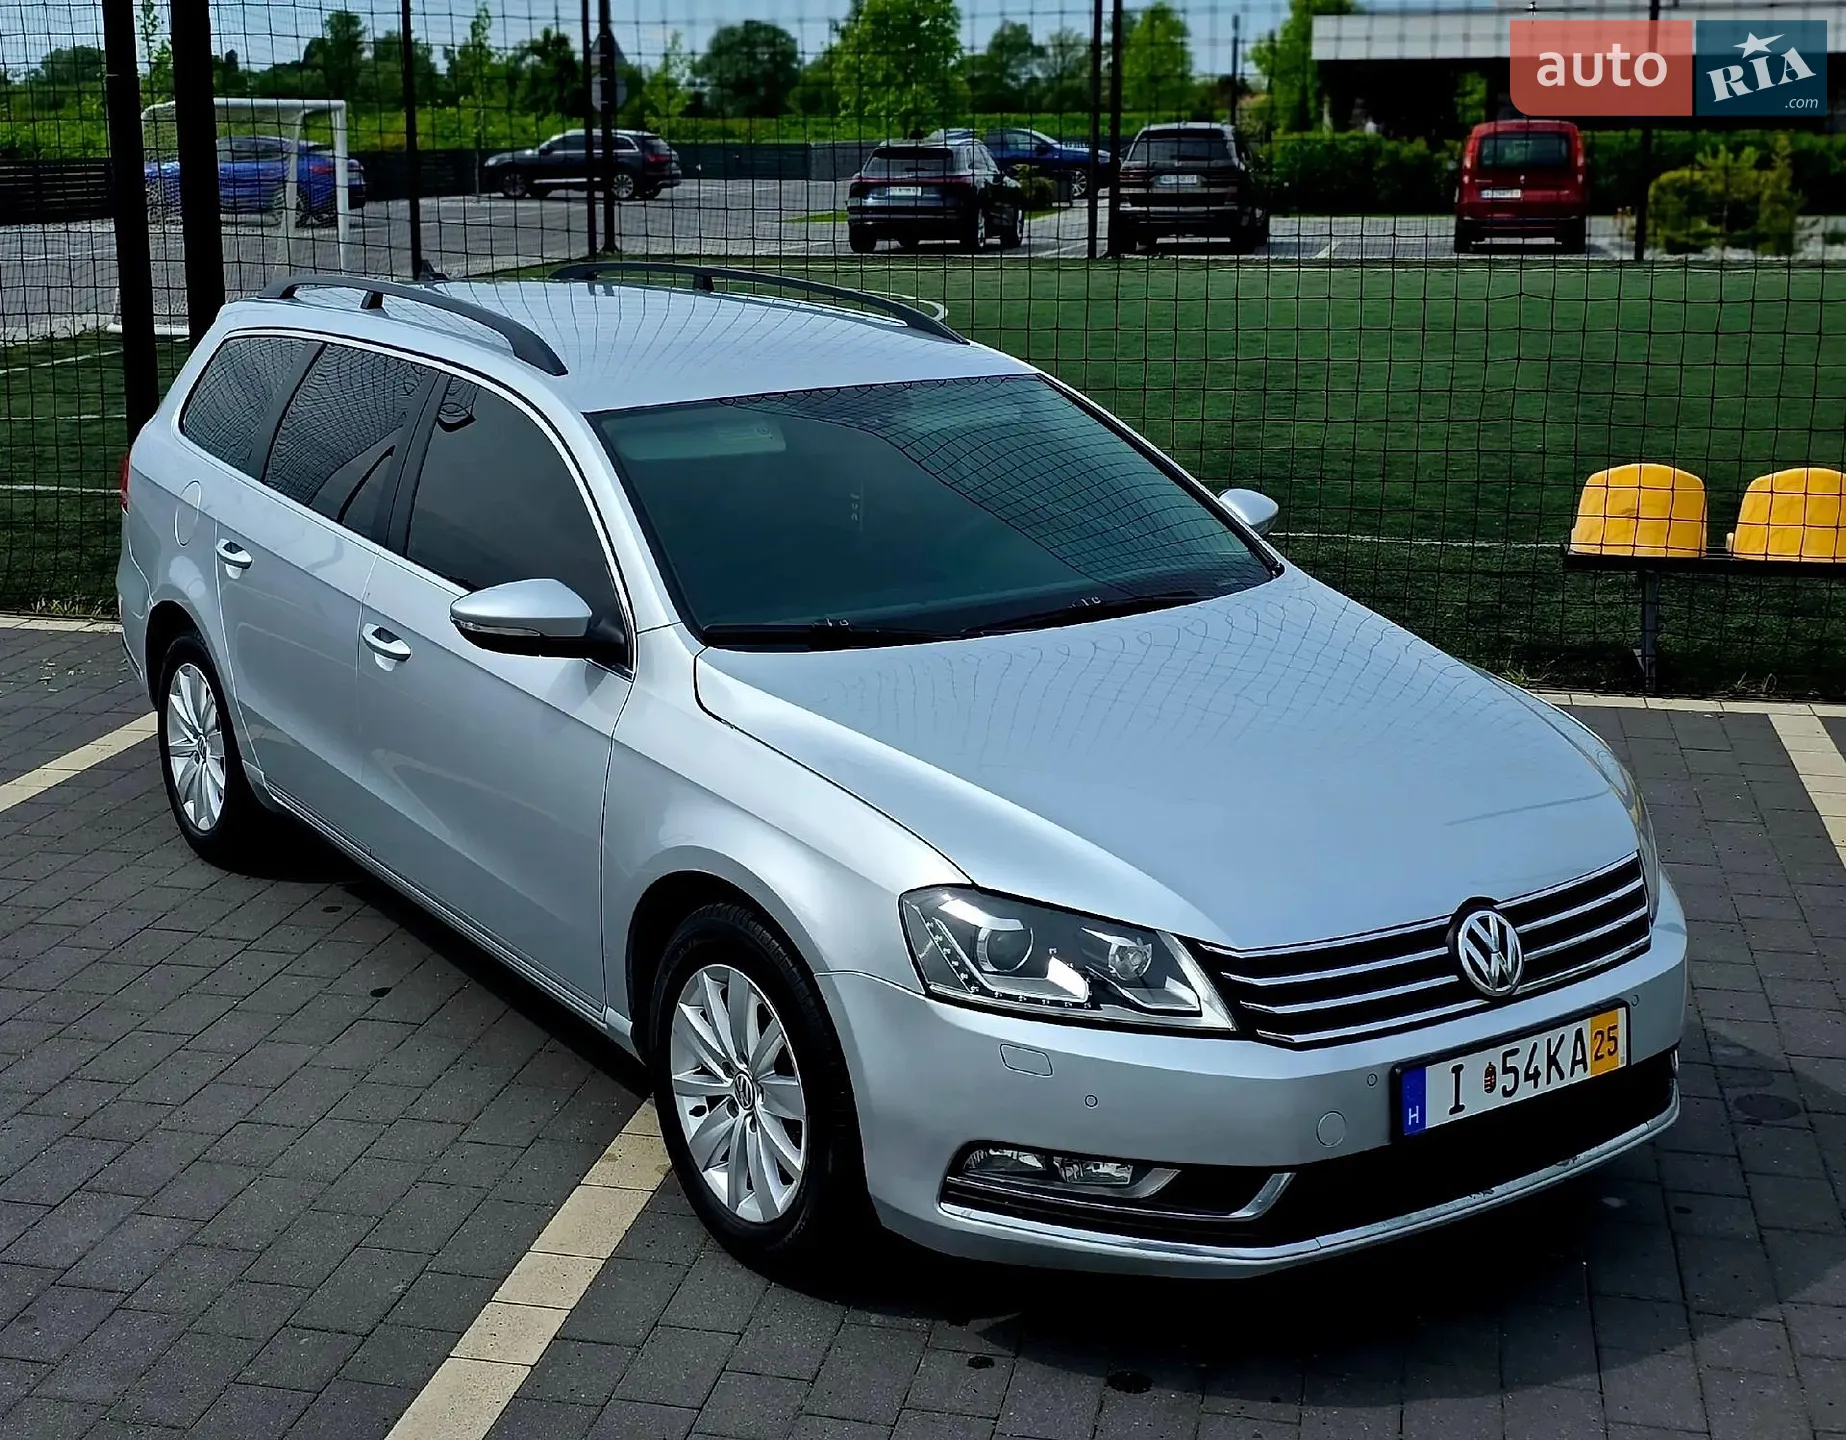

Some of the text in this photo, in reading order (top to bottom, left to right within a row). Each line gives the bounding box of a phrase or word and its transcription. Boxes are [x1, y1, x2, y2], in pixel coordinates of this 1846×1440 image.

[1458, 912, 1521, 992] VW
[1449, 1024, 1618, 1115] I 54KA 25
[1408, 1105, 1420, 1126] H
